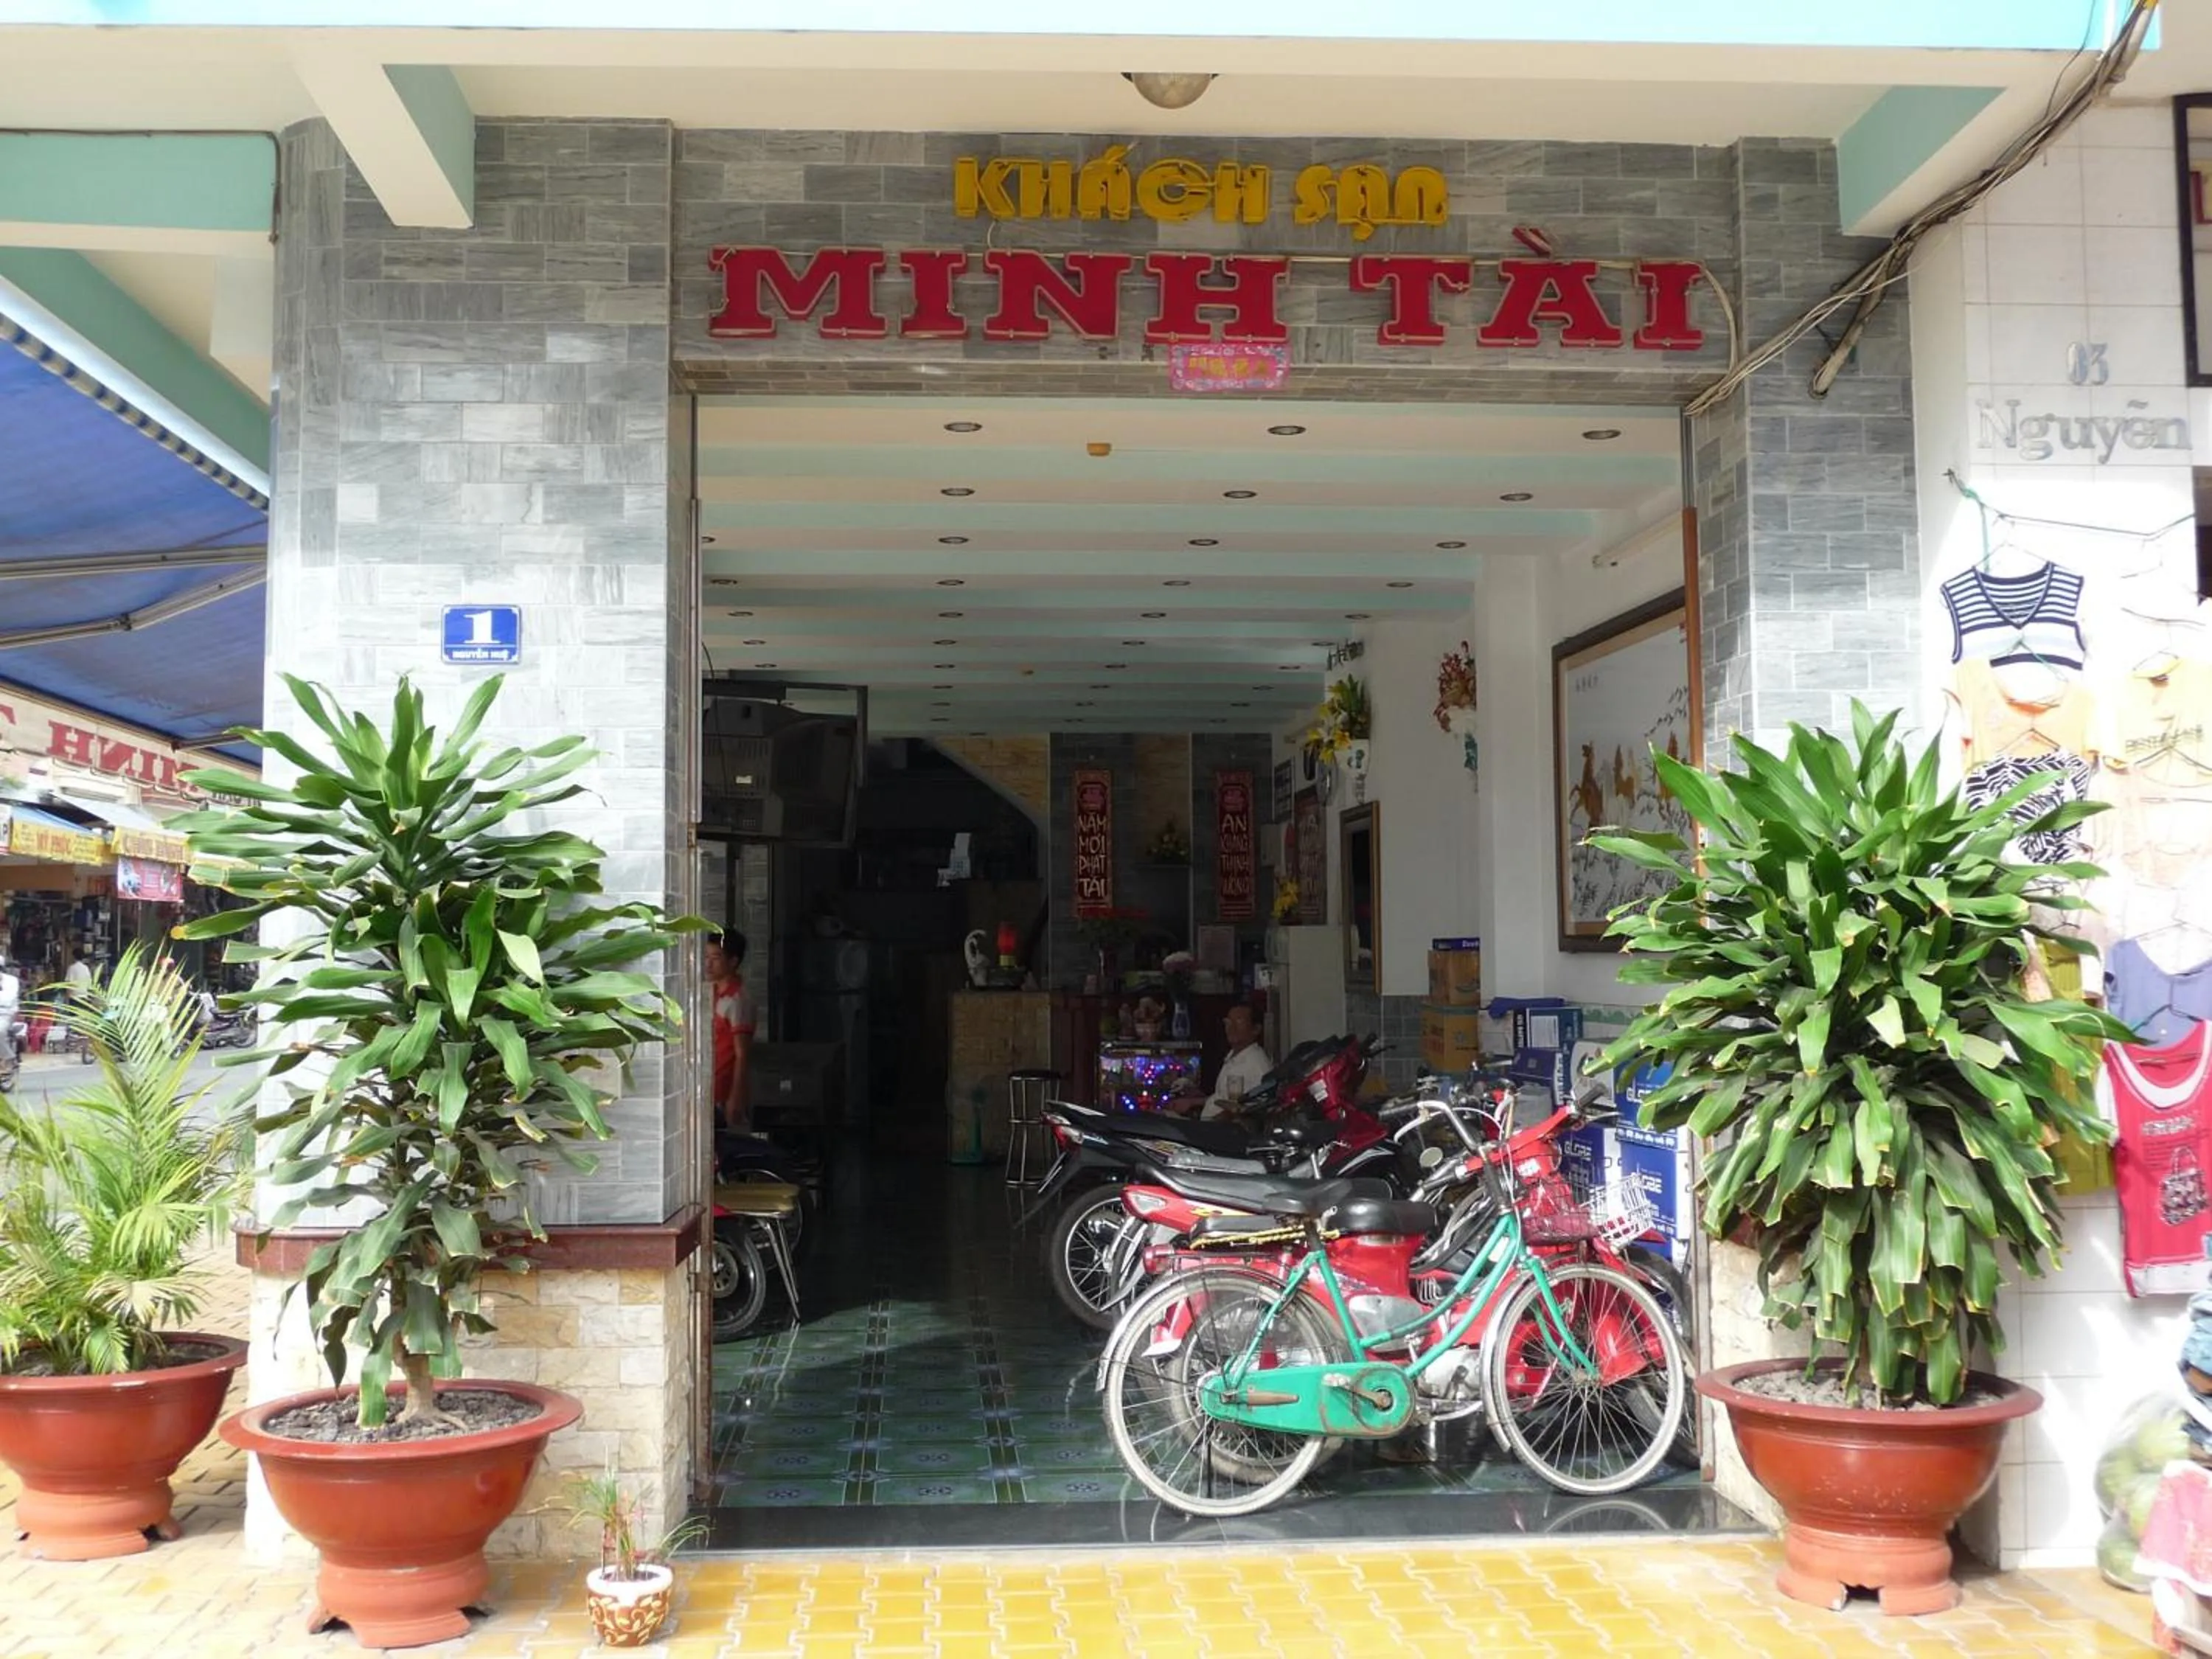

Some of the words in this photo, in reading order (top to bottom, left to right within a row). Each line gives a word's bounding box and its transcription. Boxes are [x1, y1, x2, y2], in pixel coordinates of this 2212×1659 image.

[954, 143, 1270, 224] KHÁCH
[1293, 164, 1448, 241] SẠN
[707, 246, 1290, 343] MINH
[1350, 225, 1705, 350] TÀI
[463, 611, 501, 644] 1
[1222, 813, 1248, 833] AN
